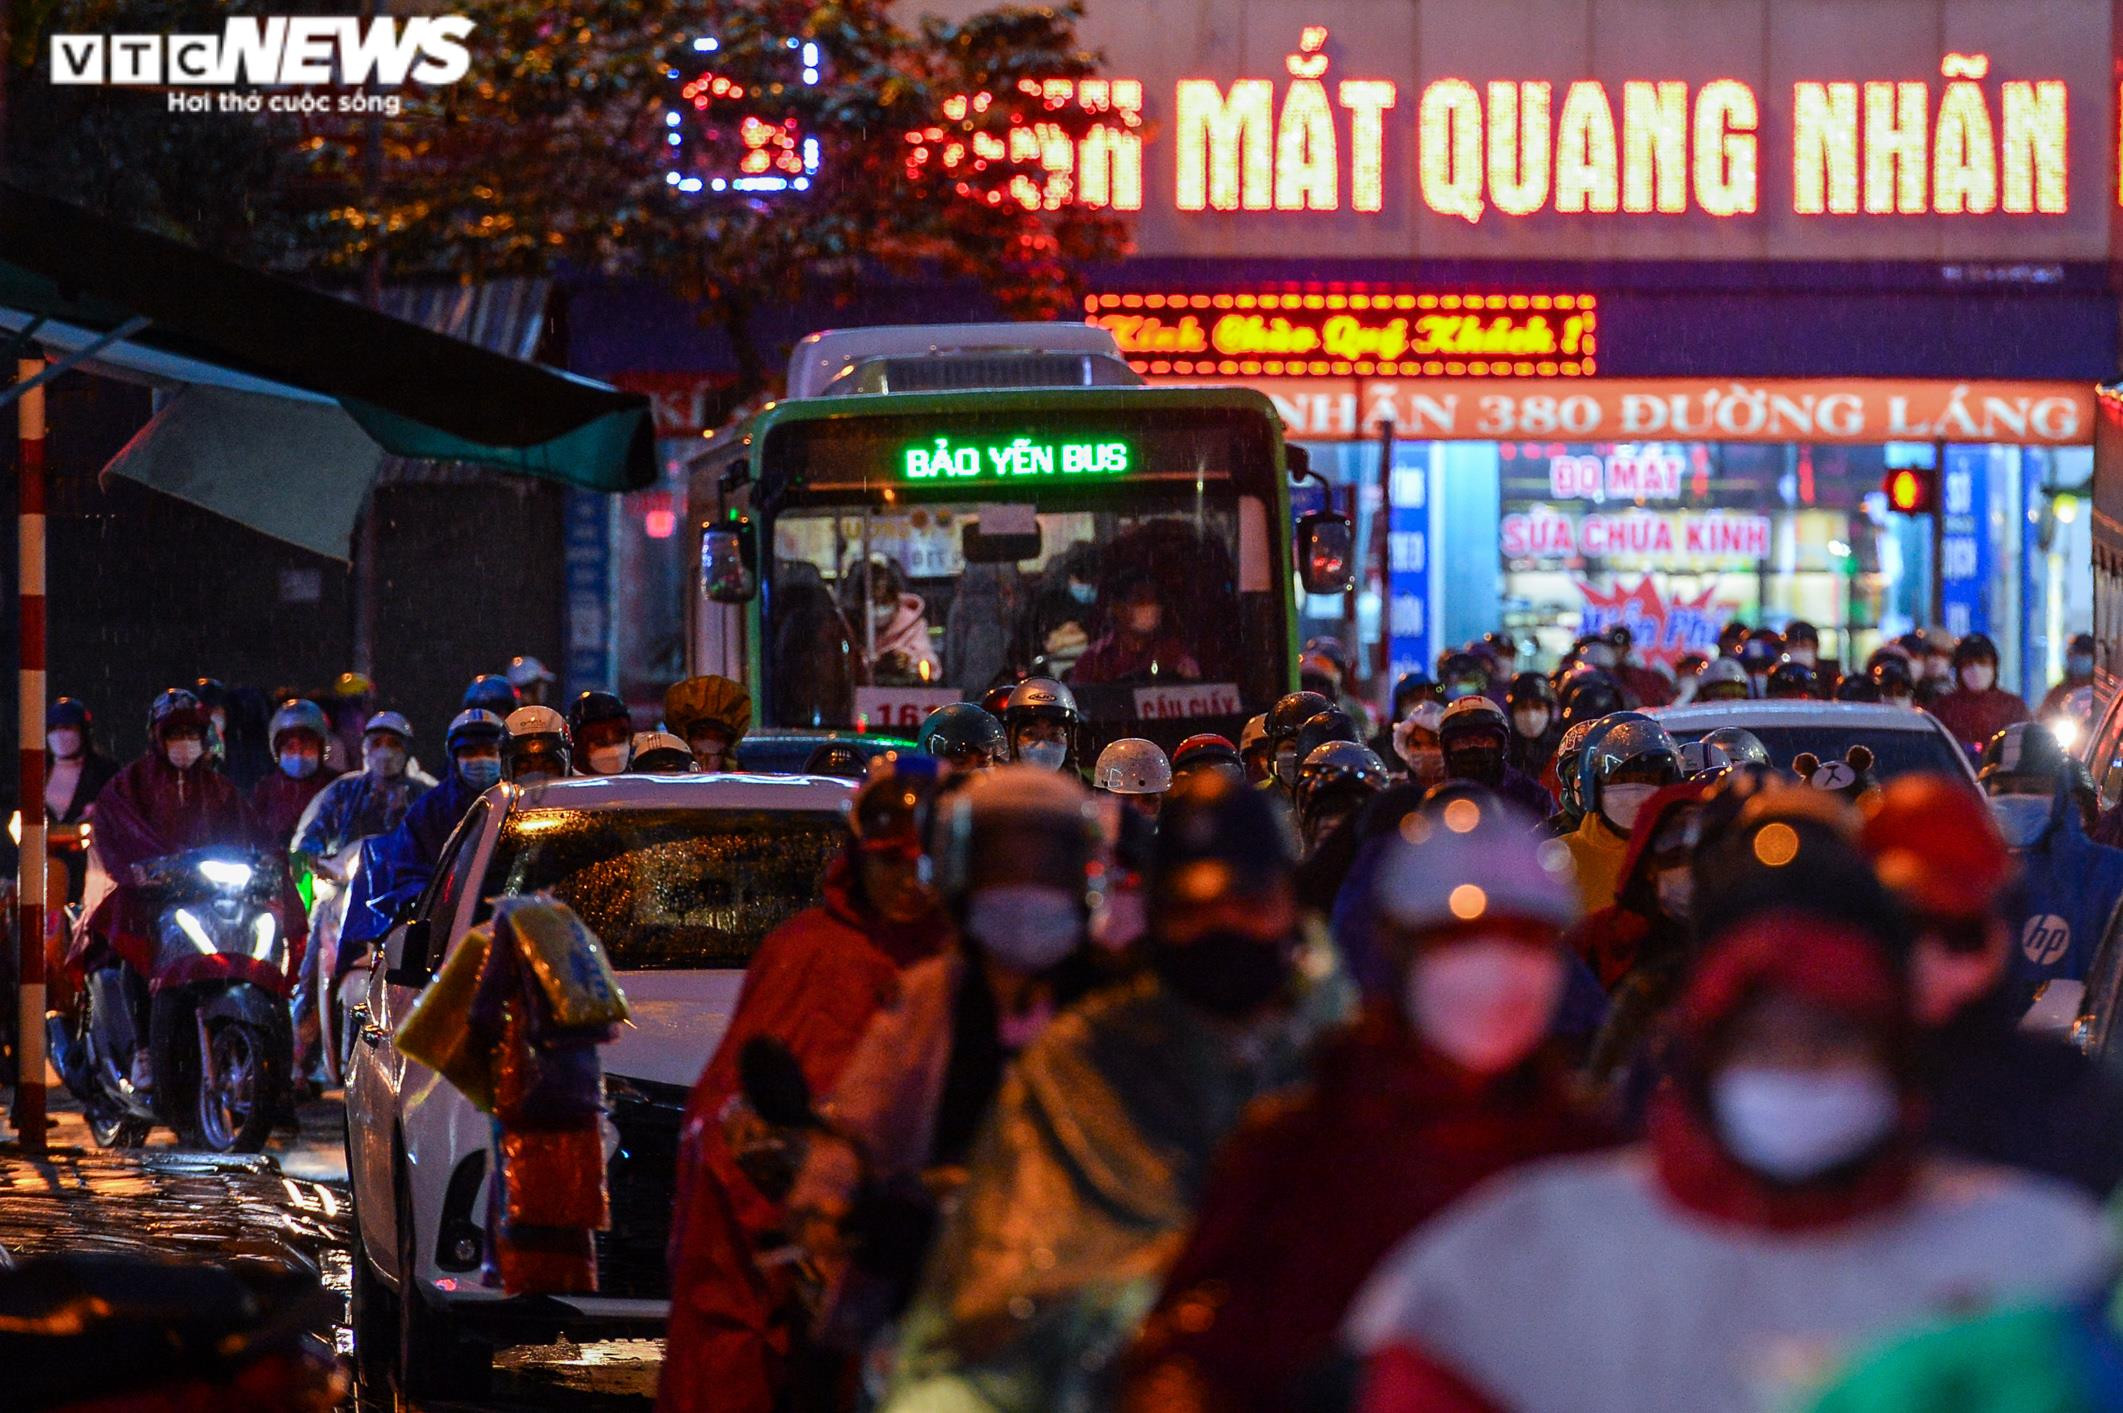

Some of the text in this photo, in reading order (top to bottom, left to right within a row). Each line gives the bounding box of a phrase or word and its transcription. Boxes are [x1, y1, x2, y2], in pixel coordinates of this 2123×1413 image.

[1175, 26, 1396, 211] MẮT
[1419, 78, 1758, 223] QUANG
[1793, 52, 2067, 213] NHÃN
[1270, 382, 2077, 439] NHÃN 380 ĐƯỜNG LÁNG
[905, 438, 980, 478] BẢO
[1062, 443, 1127, 473] BUS
[2024, 913, 2067, 964] hp
